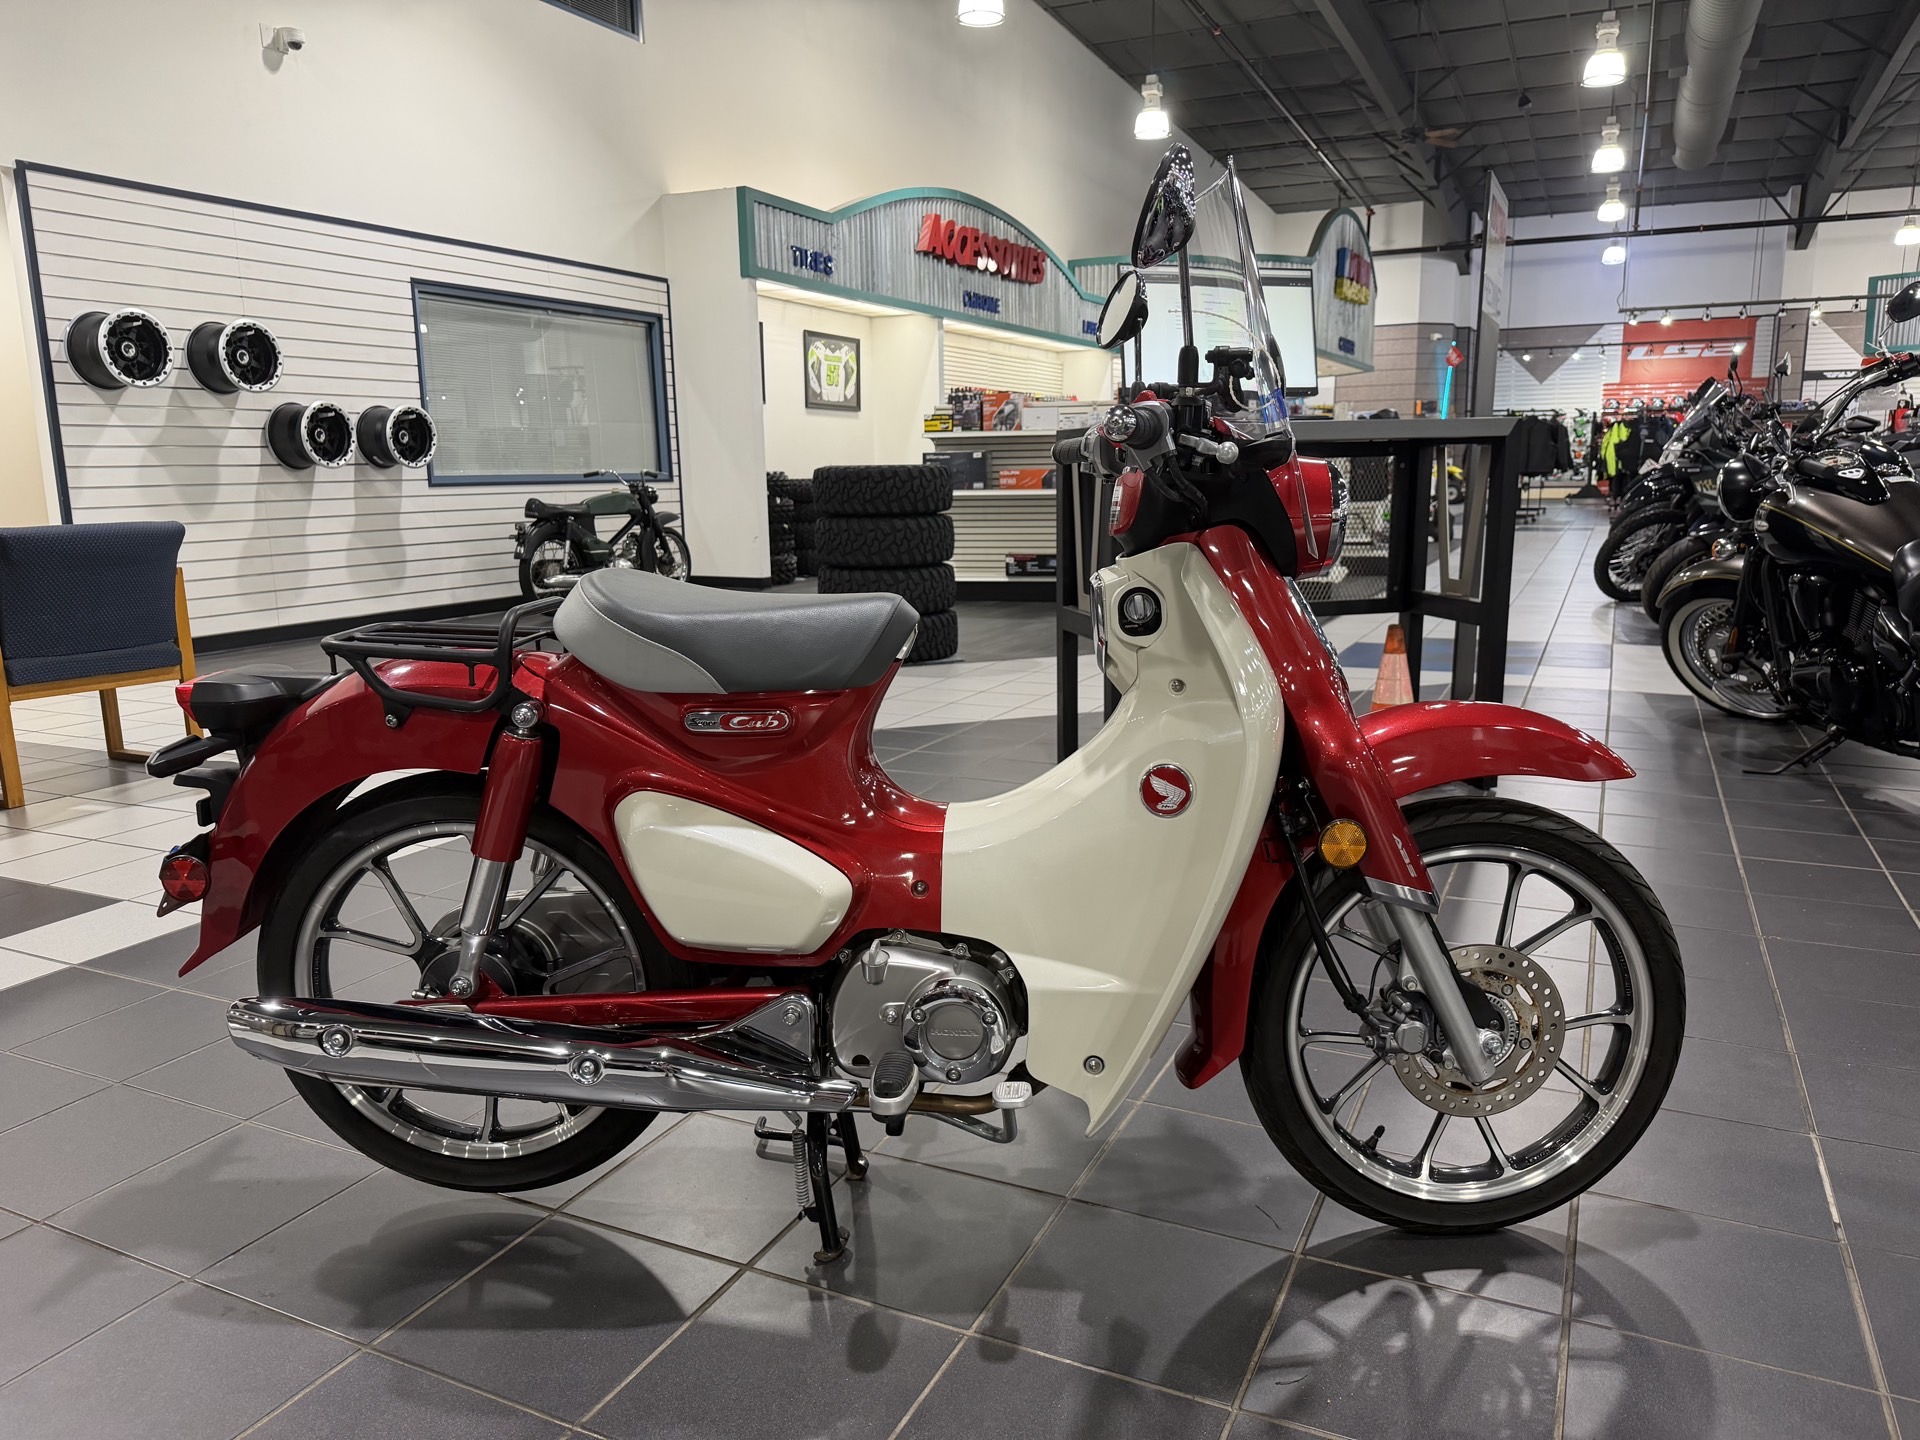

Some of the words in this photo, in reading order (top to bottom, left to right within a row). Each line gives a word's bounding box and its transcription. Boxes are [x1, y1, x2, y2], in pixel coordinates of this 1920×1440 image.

[790, 245, 834, 276] TIRES
[918, 213, 1046, 284] ACCESSORIES
[1627, 342, 1747, 360] LS2
[729, 716, 779, 728] Cub
[1392, 833, 1417, 877] ABS
[931, 1028, 979, 1037] HONDA
